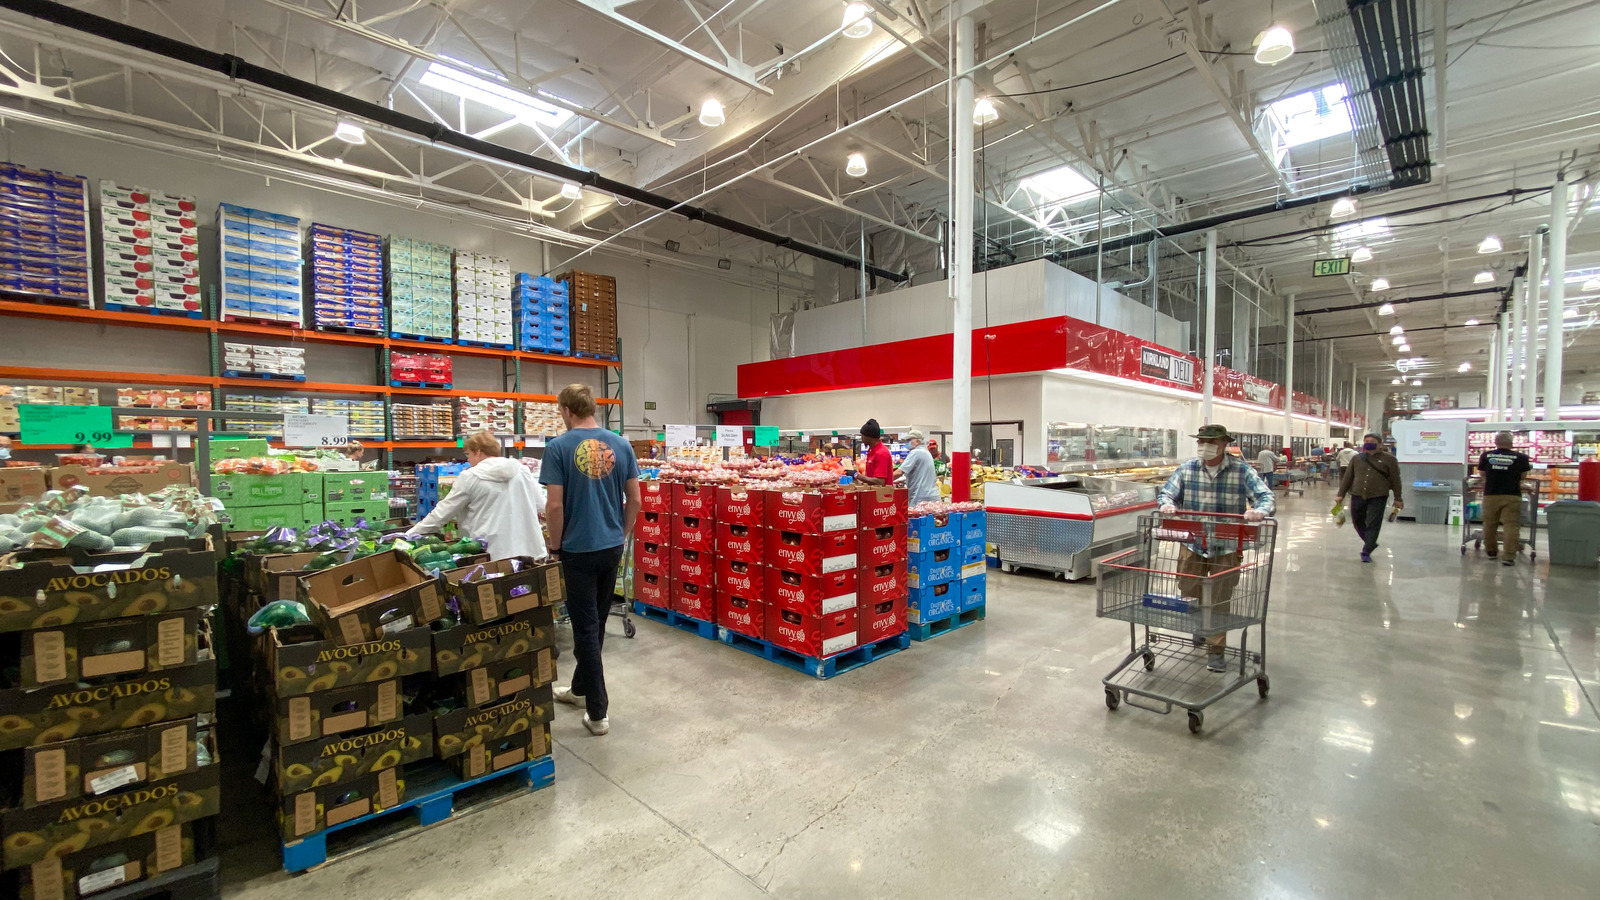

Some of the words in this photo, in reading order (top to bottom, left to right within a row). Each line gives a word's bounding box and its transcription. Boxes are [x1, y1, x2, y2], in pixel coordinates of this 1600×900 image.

[1320, 260, 1344, 274] EXIT
[1143, 351, 1169, 370] KIRKLAND
[1174, 360, 1190, 382] DELI
[75, 432, 112, 444] 9.99
[322, 436, 347, 446] 8.99
[682, 498, 696, 510] envy
[728, 504, 743, 518] envy
[778, 509, 796, 524] envy
[874, 508, 889, 520] envy
[682, 531, 696, 543] envy
[728, 540, 743, 554] envy
[873, 544, 889, 557] envy
[778, 548, 796, 564] envy
[680, 564, 696, 577] envy
[46, 566, 170, 592] AVOCADOS
[728, 576, 743, 590] envy
[873, 582, 889, 594] envy
[681, 596, 696, 609] envy
[778, 588, 796, 603] envy
[728, 610, 744, 625] envy
[872, 618, 889, 631] envy
[464, 620, 530, 646] AVOCADOS
[778, 626, 796, 642] envy
[316, 640, 400, 662] AVOCADOS
[50, 678, 170, 708] AVOCADOS
[464, 698, 530, 728] AVOCADOS
[320, 728, 406, 758] AVOCADOS
[58, 783, 178, 823] AVOCADOS
